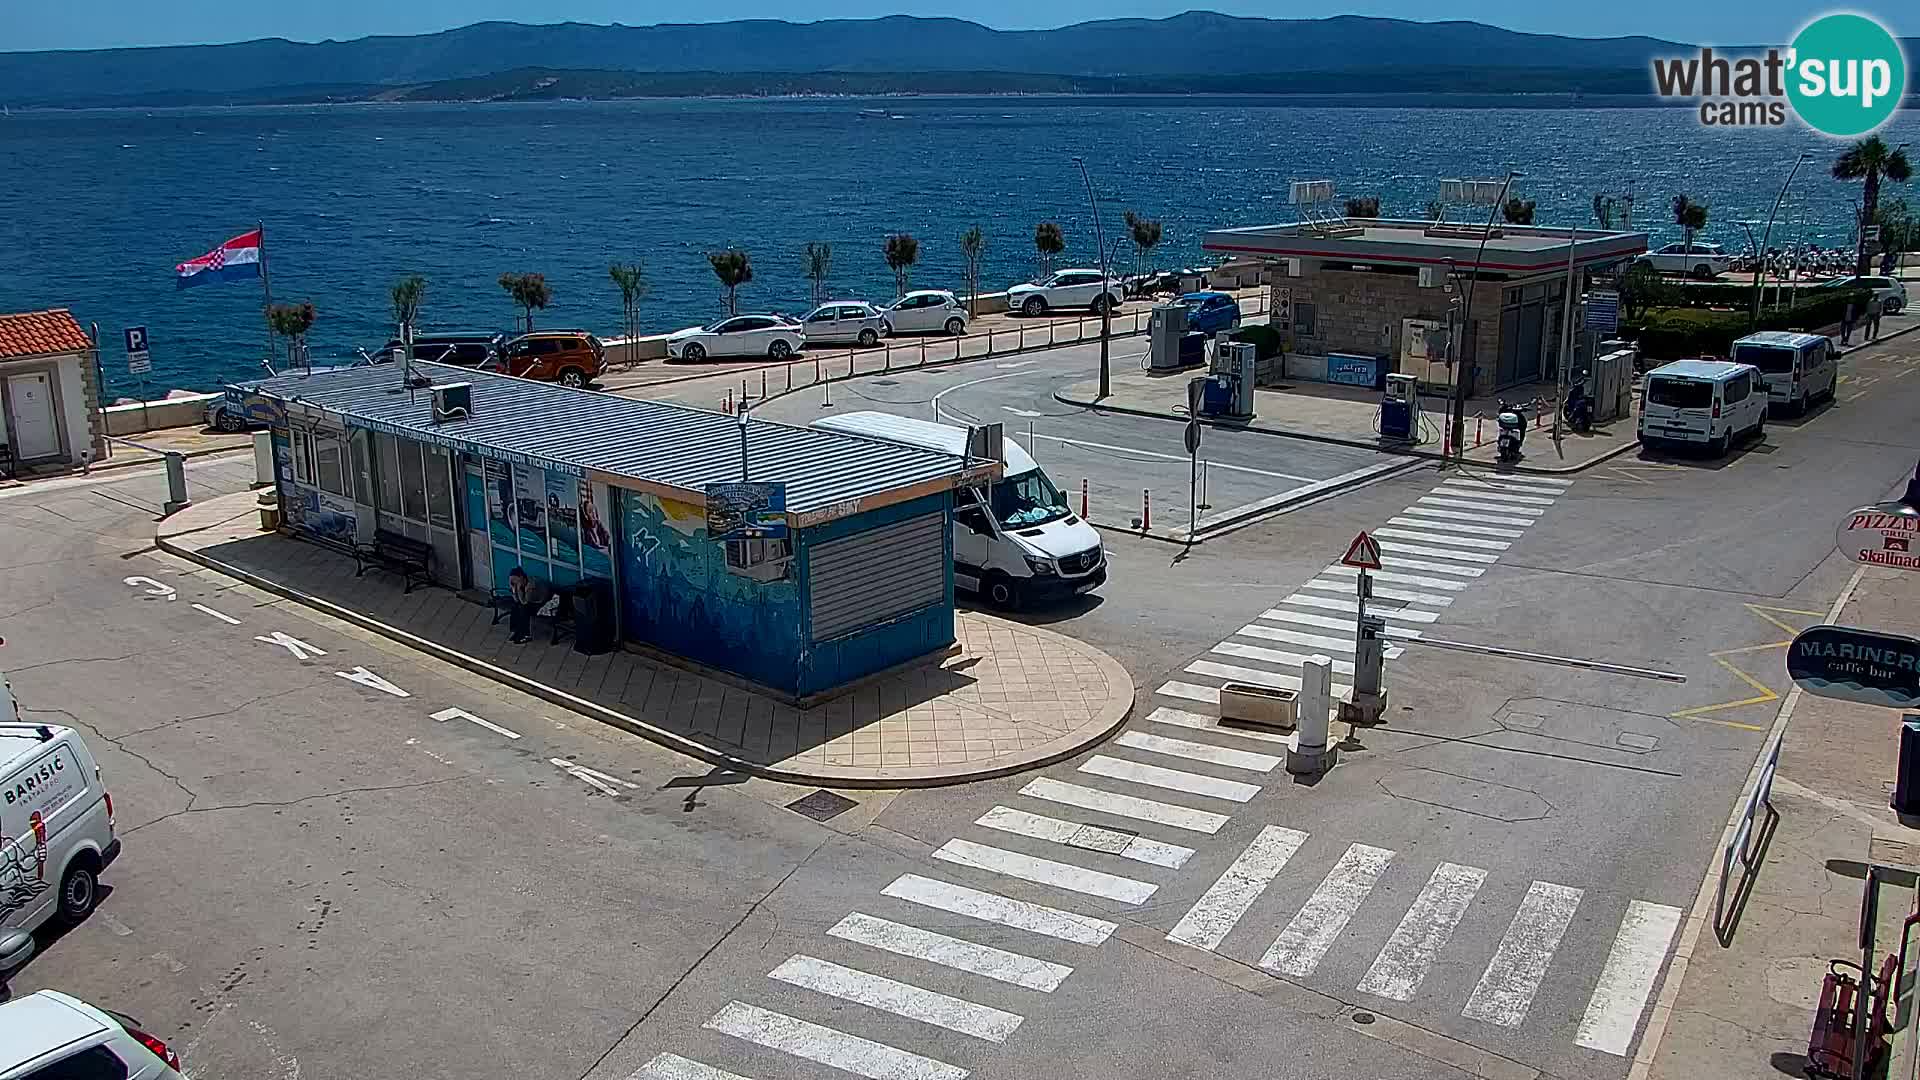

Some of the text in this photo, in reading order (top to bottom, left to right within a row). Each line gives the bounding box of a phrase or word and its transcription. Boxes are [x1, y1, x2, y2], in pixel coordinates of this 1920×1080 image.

[129, 331, 142, 349] P
[395, 426, 436, 444] AUTOBUSNA
[437, 436, 467, 452] POSTAJA
[477, 445, 493, 456] BUS
[494, 448, 527, 464] STATION
[528, 456, 554, 470] TICKET
[555, 462, 582, 477] OFFICE
[1847, 514, 1920, 533] PIZZE
[1880, 529, 1916, 540] GRILL
[1828, 661, 1896, 679] caffe bar
[4, 754, 65, 805] BARIŠIĆ
